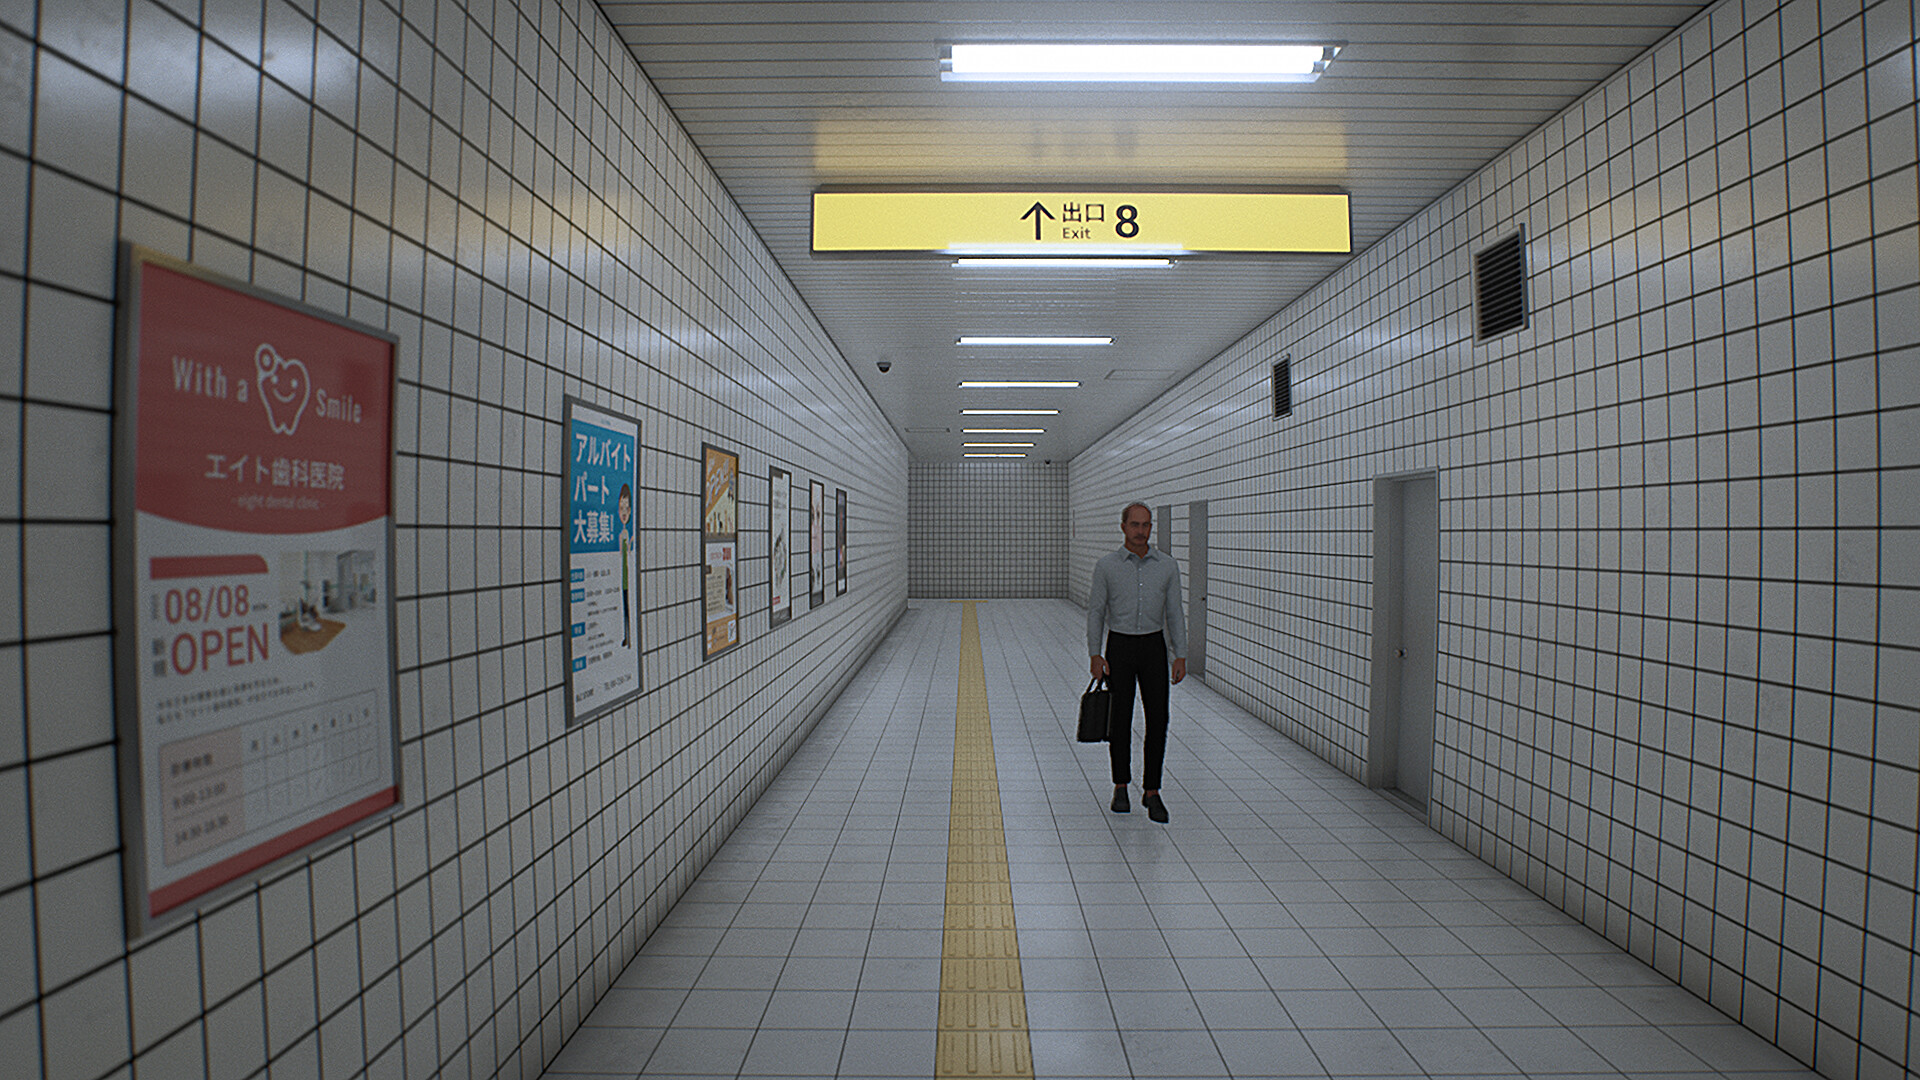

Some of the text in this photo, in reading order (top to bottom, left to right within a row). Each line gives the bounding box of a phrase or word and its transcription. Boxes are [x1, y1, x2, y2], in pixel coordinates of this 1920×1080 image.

[1062, 202, 1139, 238] 出口 8
[1062, 226, 1091, 239] Exit
[172, 356, 362, 423] With a Smile
[575, 433, 631, 472] アルバイト
[204, 454, 345, 491] エイト歯科医院
[574, 471, 609, 504] パート
[164, 584, 249, 624] 08/08
[171, 622, 269, 675] OPEN
